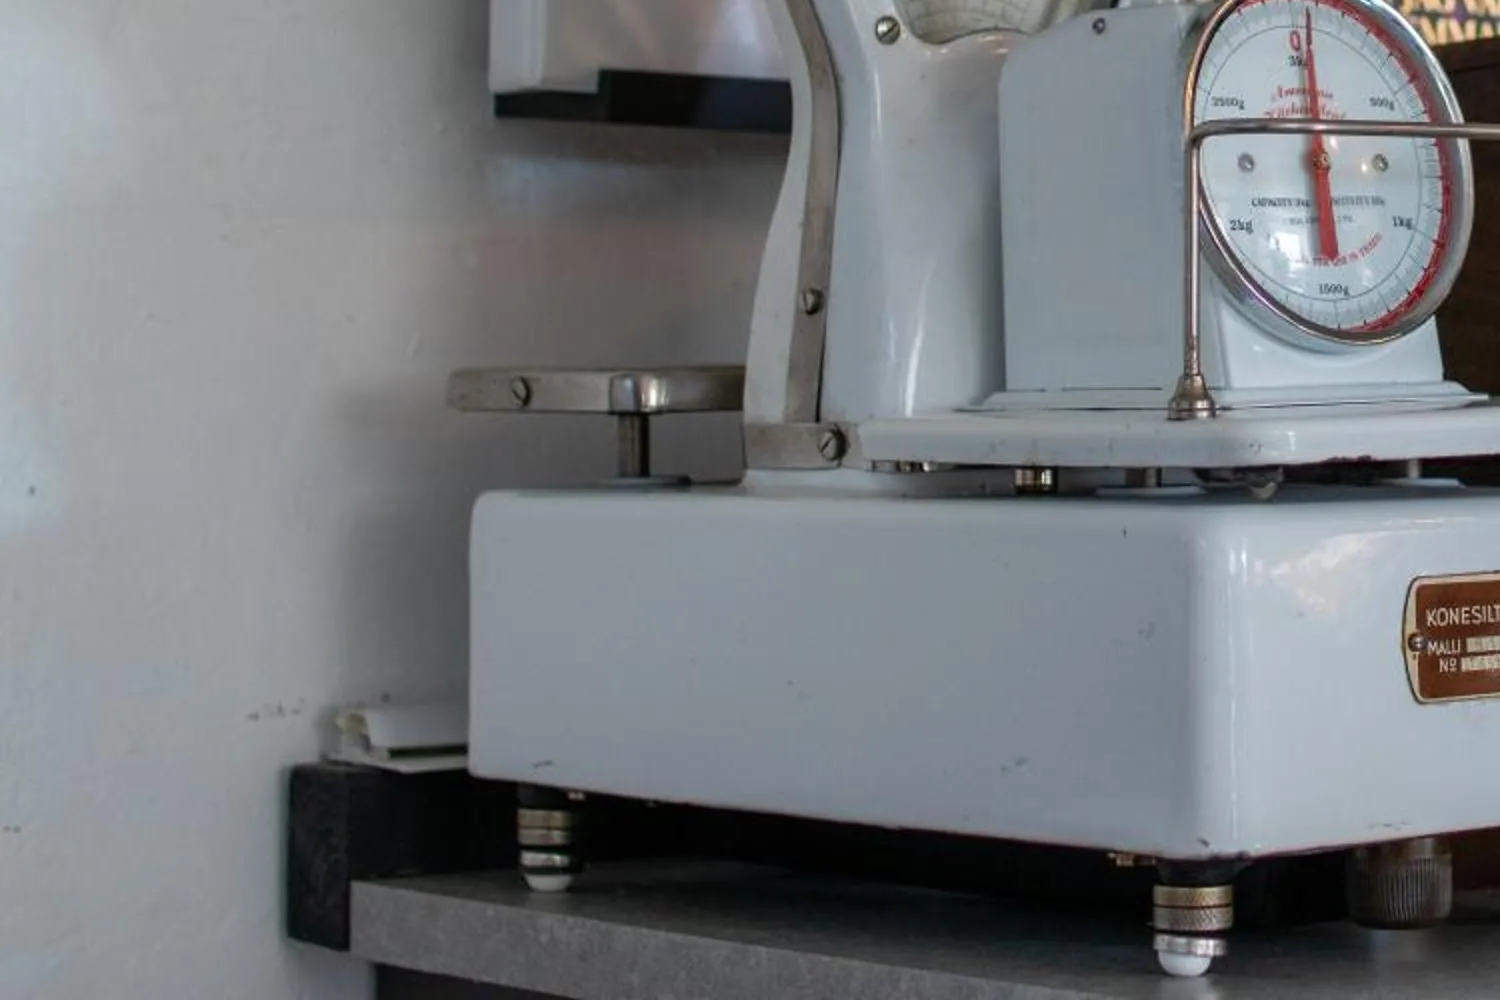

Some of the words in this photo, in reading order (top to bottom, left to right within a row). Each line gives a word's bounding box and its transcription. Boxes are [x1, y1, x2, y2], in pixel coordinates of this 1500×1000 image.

[1289, 30, 1301, 53] 0
[1229, 219, 1254, 234] 2kg
[1392, 215, 1414, 230] 1kg
[1319, 283, 1350, 296] 1500g
[1427, 638, 1461, 656] MALLI
